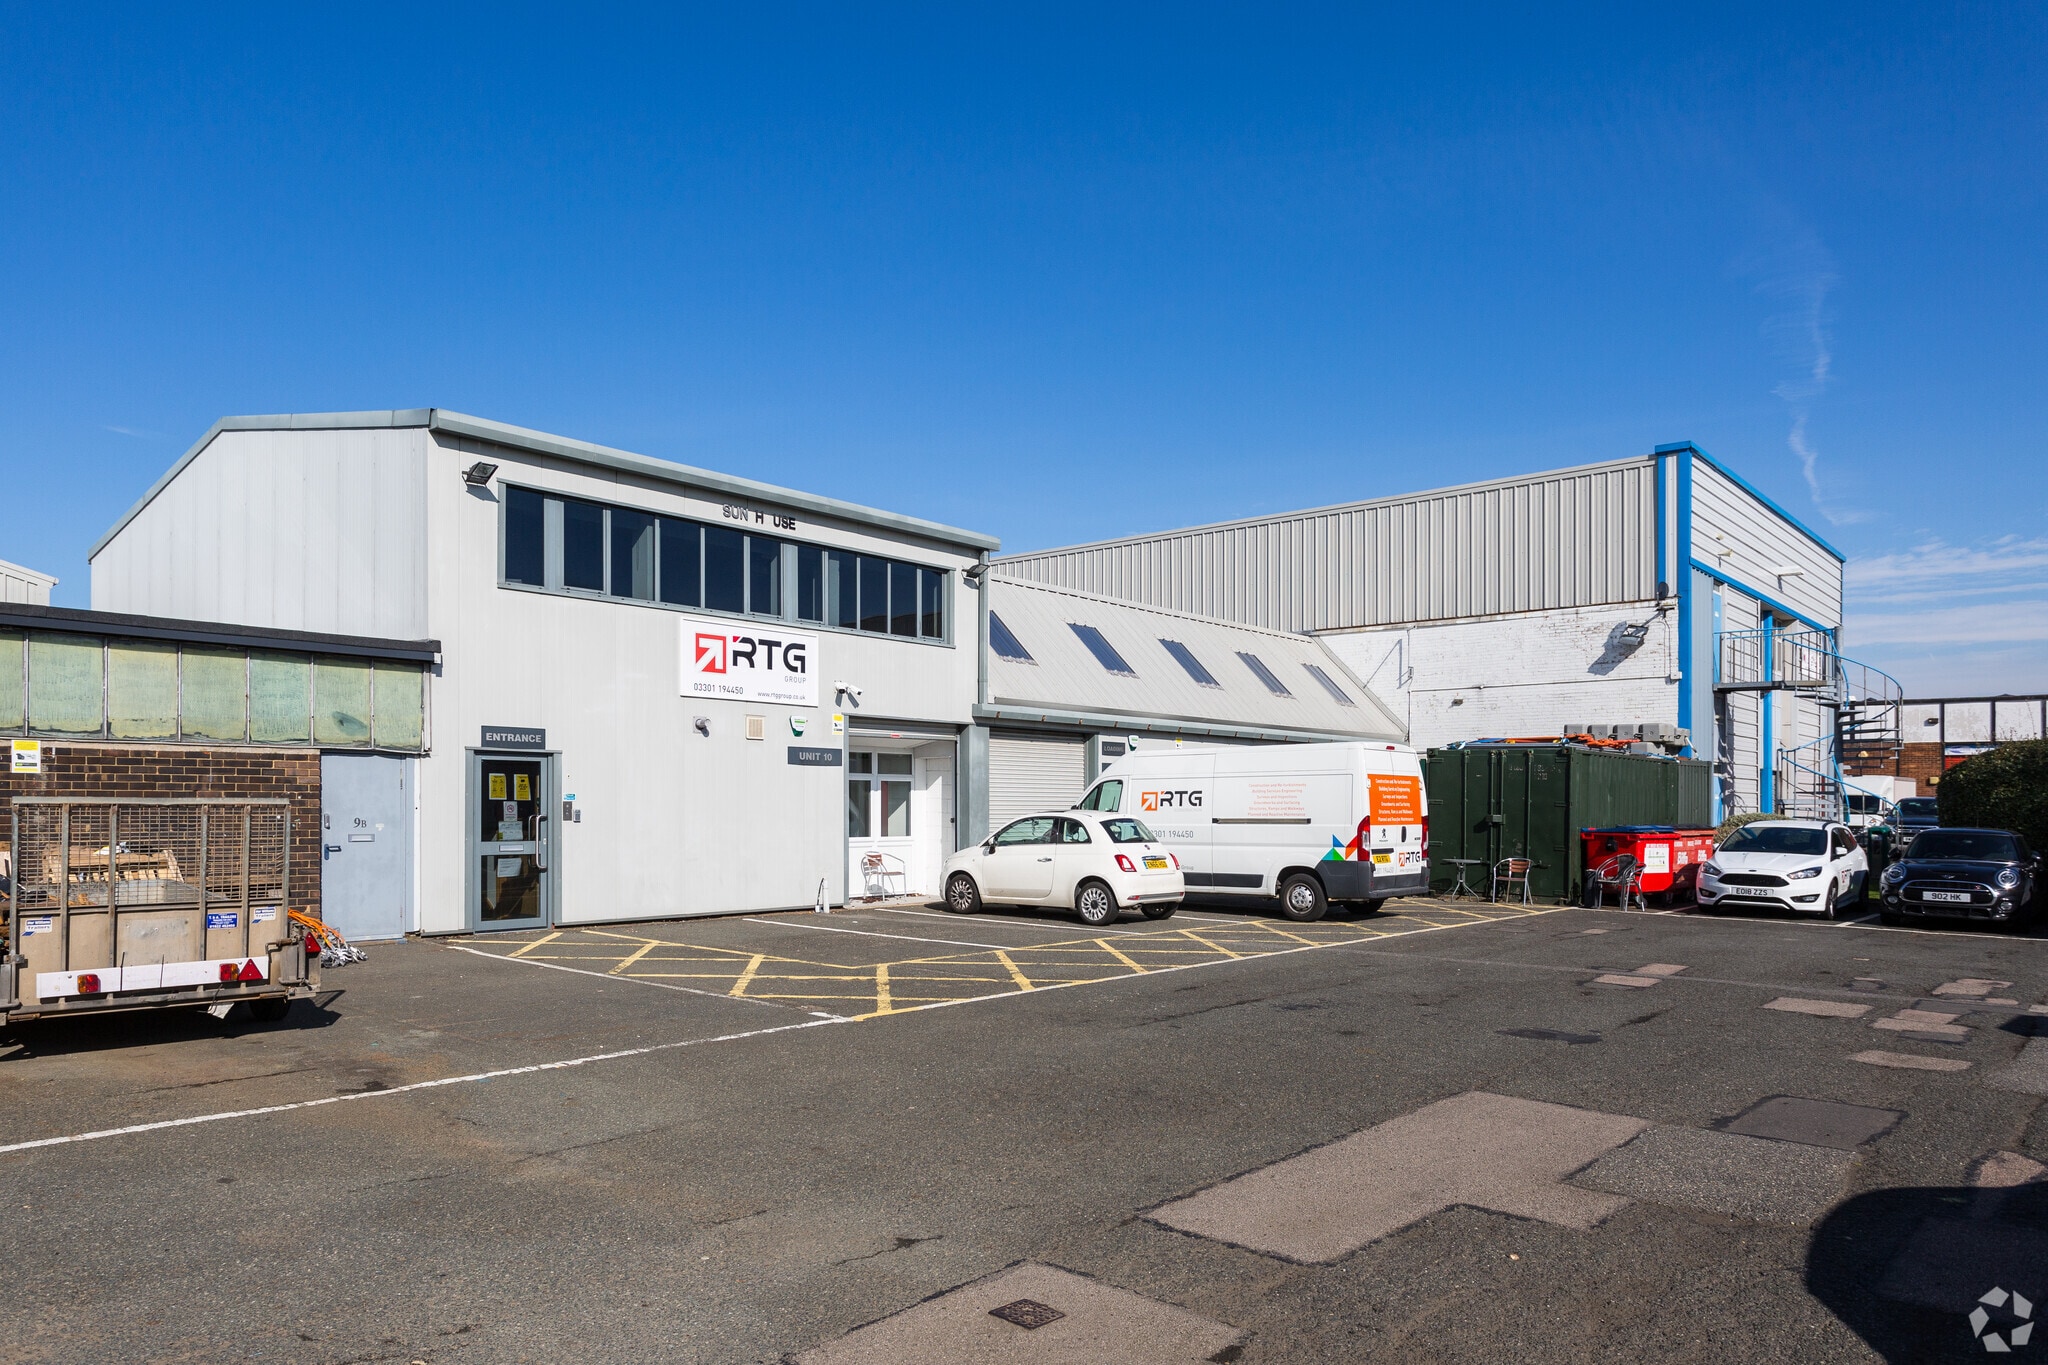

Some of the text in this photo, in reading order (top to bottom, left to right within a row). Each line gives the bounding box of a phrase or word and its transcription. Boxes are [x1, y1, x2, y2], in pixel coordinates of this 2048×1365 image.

[723, 504, 748, 521] SUN
[732, 636, 806, 673] RTG
[784, 675, 807, 684] GROUP
[693, 682, 744, 695] 03301 194450
[757, 691, 806, 701] www.rtggroup.co.uk
[485, 732, 542, 743] ENTRANCE
[799, 752, 833, 762] UNIT 10
[1160, 790, 1202, 807] RTG
[353, 817, 367, 829] 9B
[1168, 830, 1194, 839] 194450
[1405, 852, 1420, 863] RTG
[1753, 888, 1768, 896] ZZS
[1931, 892, 1961, 901] 902 HK
